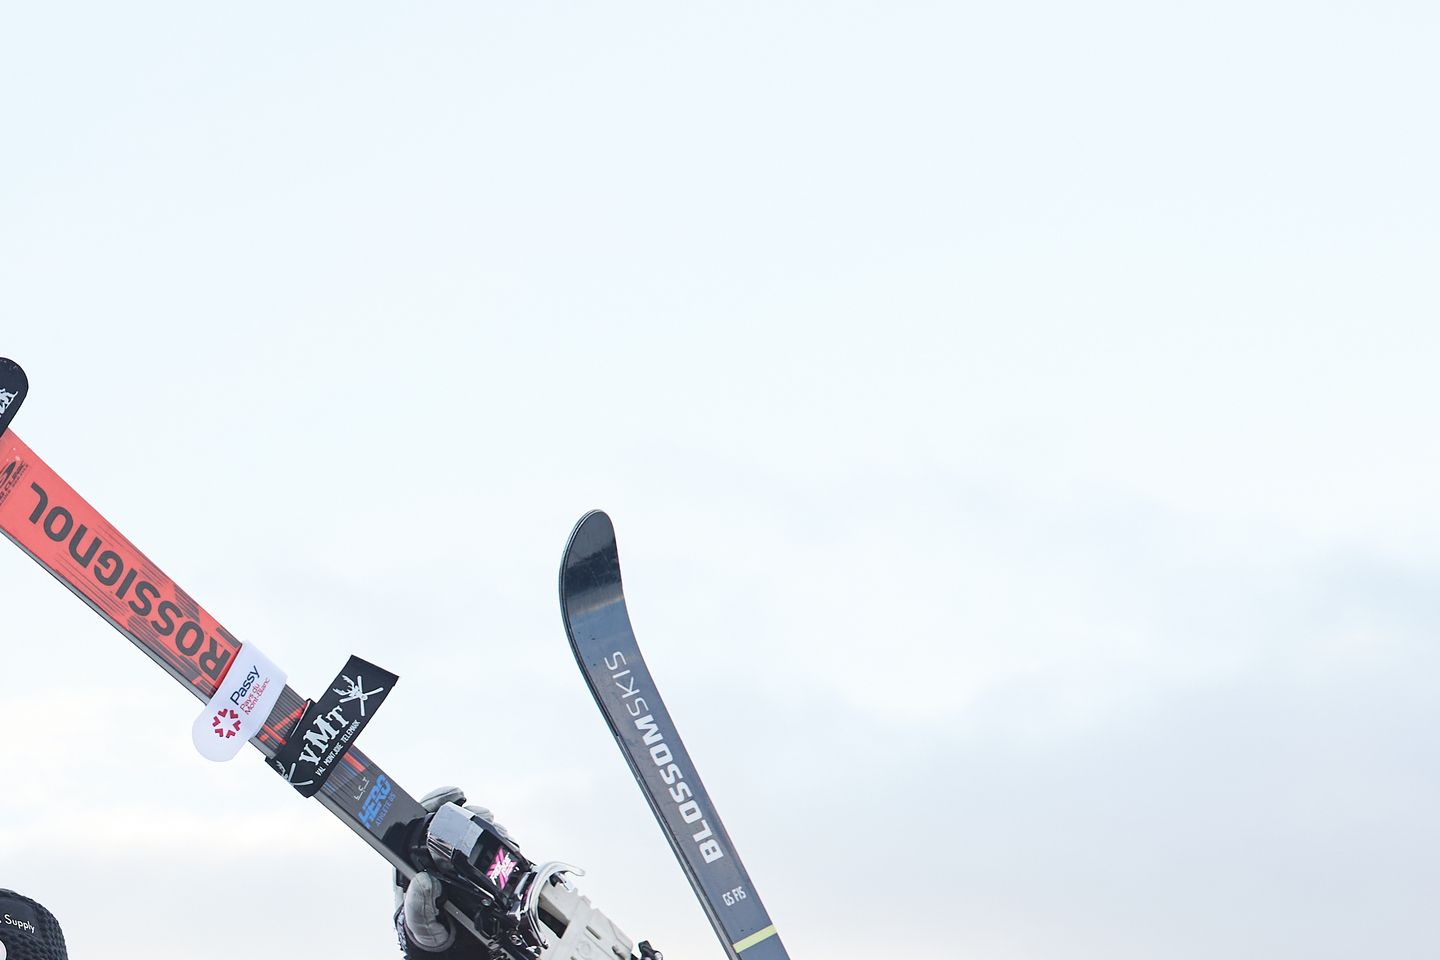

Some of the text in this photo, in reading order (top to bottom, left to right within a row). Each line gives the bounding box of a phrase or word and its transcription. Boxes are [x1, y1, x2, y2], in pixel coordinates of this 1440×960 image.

[28, 481, 232, 681] ROSSIGNOL
[229, 665, 260, 706] Passy
[239, 681, 261, 711] Pays du
[244, 677, 272, 717] Mont-Blanc
[298, 704, 350, 766] VMT
[315, 765, 327, 777] VAL
[339, 718, 361, 743] TELEMARK
[357, 773, 393, 830] HERO
[722, 886, 747, 906] GS FIS
[4, 914, 35, 934] Supply
